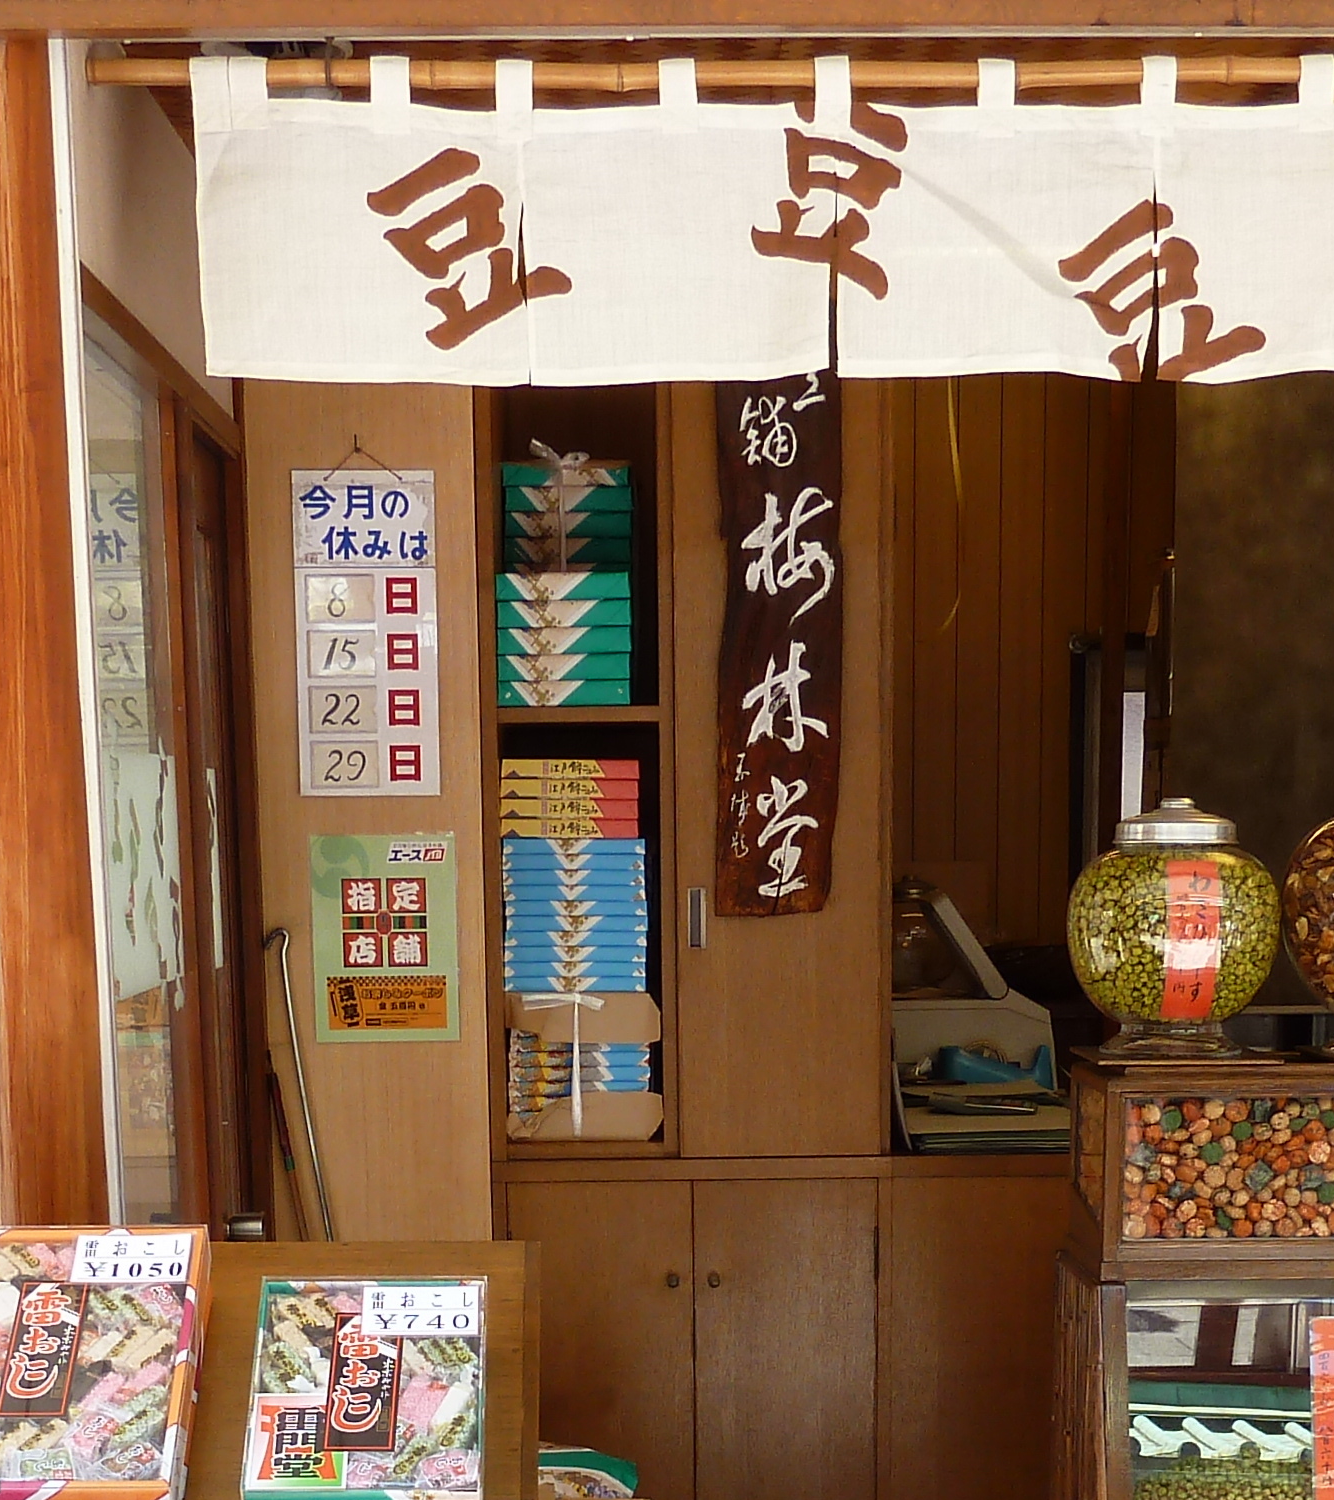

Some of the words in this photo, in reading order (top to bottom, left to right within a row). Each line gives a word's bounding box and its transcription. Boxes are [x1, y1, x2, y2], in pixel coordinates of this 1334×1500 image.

[751, 101, 907, 300] 豆
[367, 148, 572, 350] 豆
[1058, 197, 1265, 381] 豆
[299, 484, 409, 521] 今月の
[321, 525, 429, 561] 休みは
[327, 580, 348, 618] 8
[385, 577, 418, 615] 日
[321, 637, 359, 672] 15
[386, 632, 419, 671] 日
[321, 694, 362, 728] 22
[388, 689, 421, 727] 日
[742, 487, 835, 898] 梅林堂
[322, 750, 367, 785] 29
[389, 744, 422, 783] 日
[388, 850, 422, 861] エース
[347, 881, 421, 912] 指定
[349, 934, 422, 964] 店舗
[85, 1239, 186, 1257] 雷おこし
[83, 1261, 184, 1278] ¥1050
[371, 1291, 474, 1310] 雷おこし
[374, 1313, 470, 1330] ¥740
[5, 1289, 72, 1400] 雷おこし
[330, 1323, 382, 1433] 雷おこし
